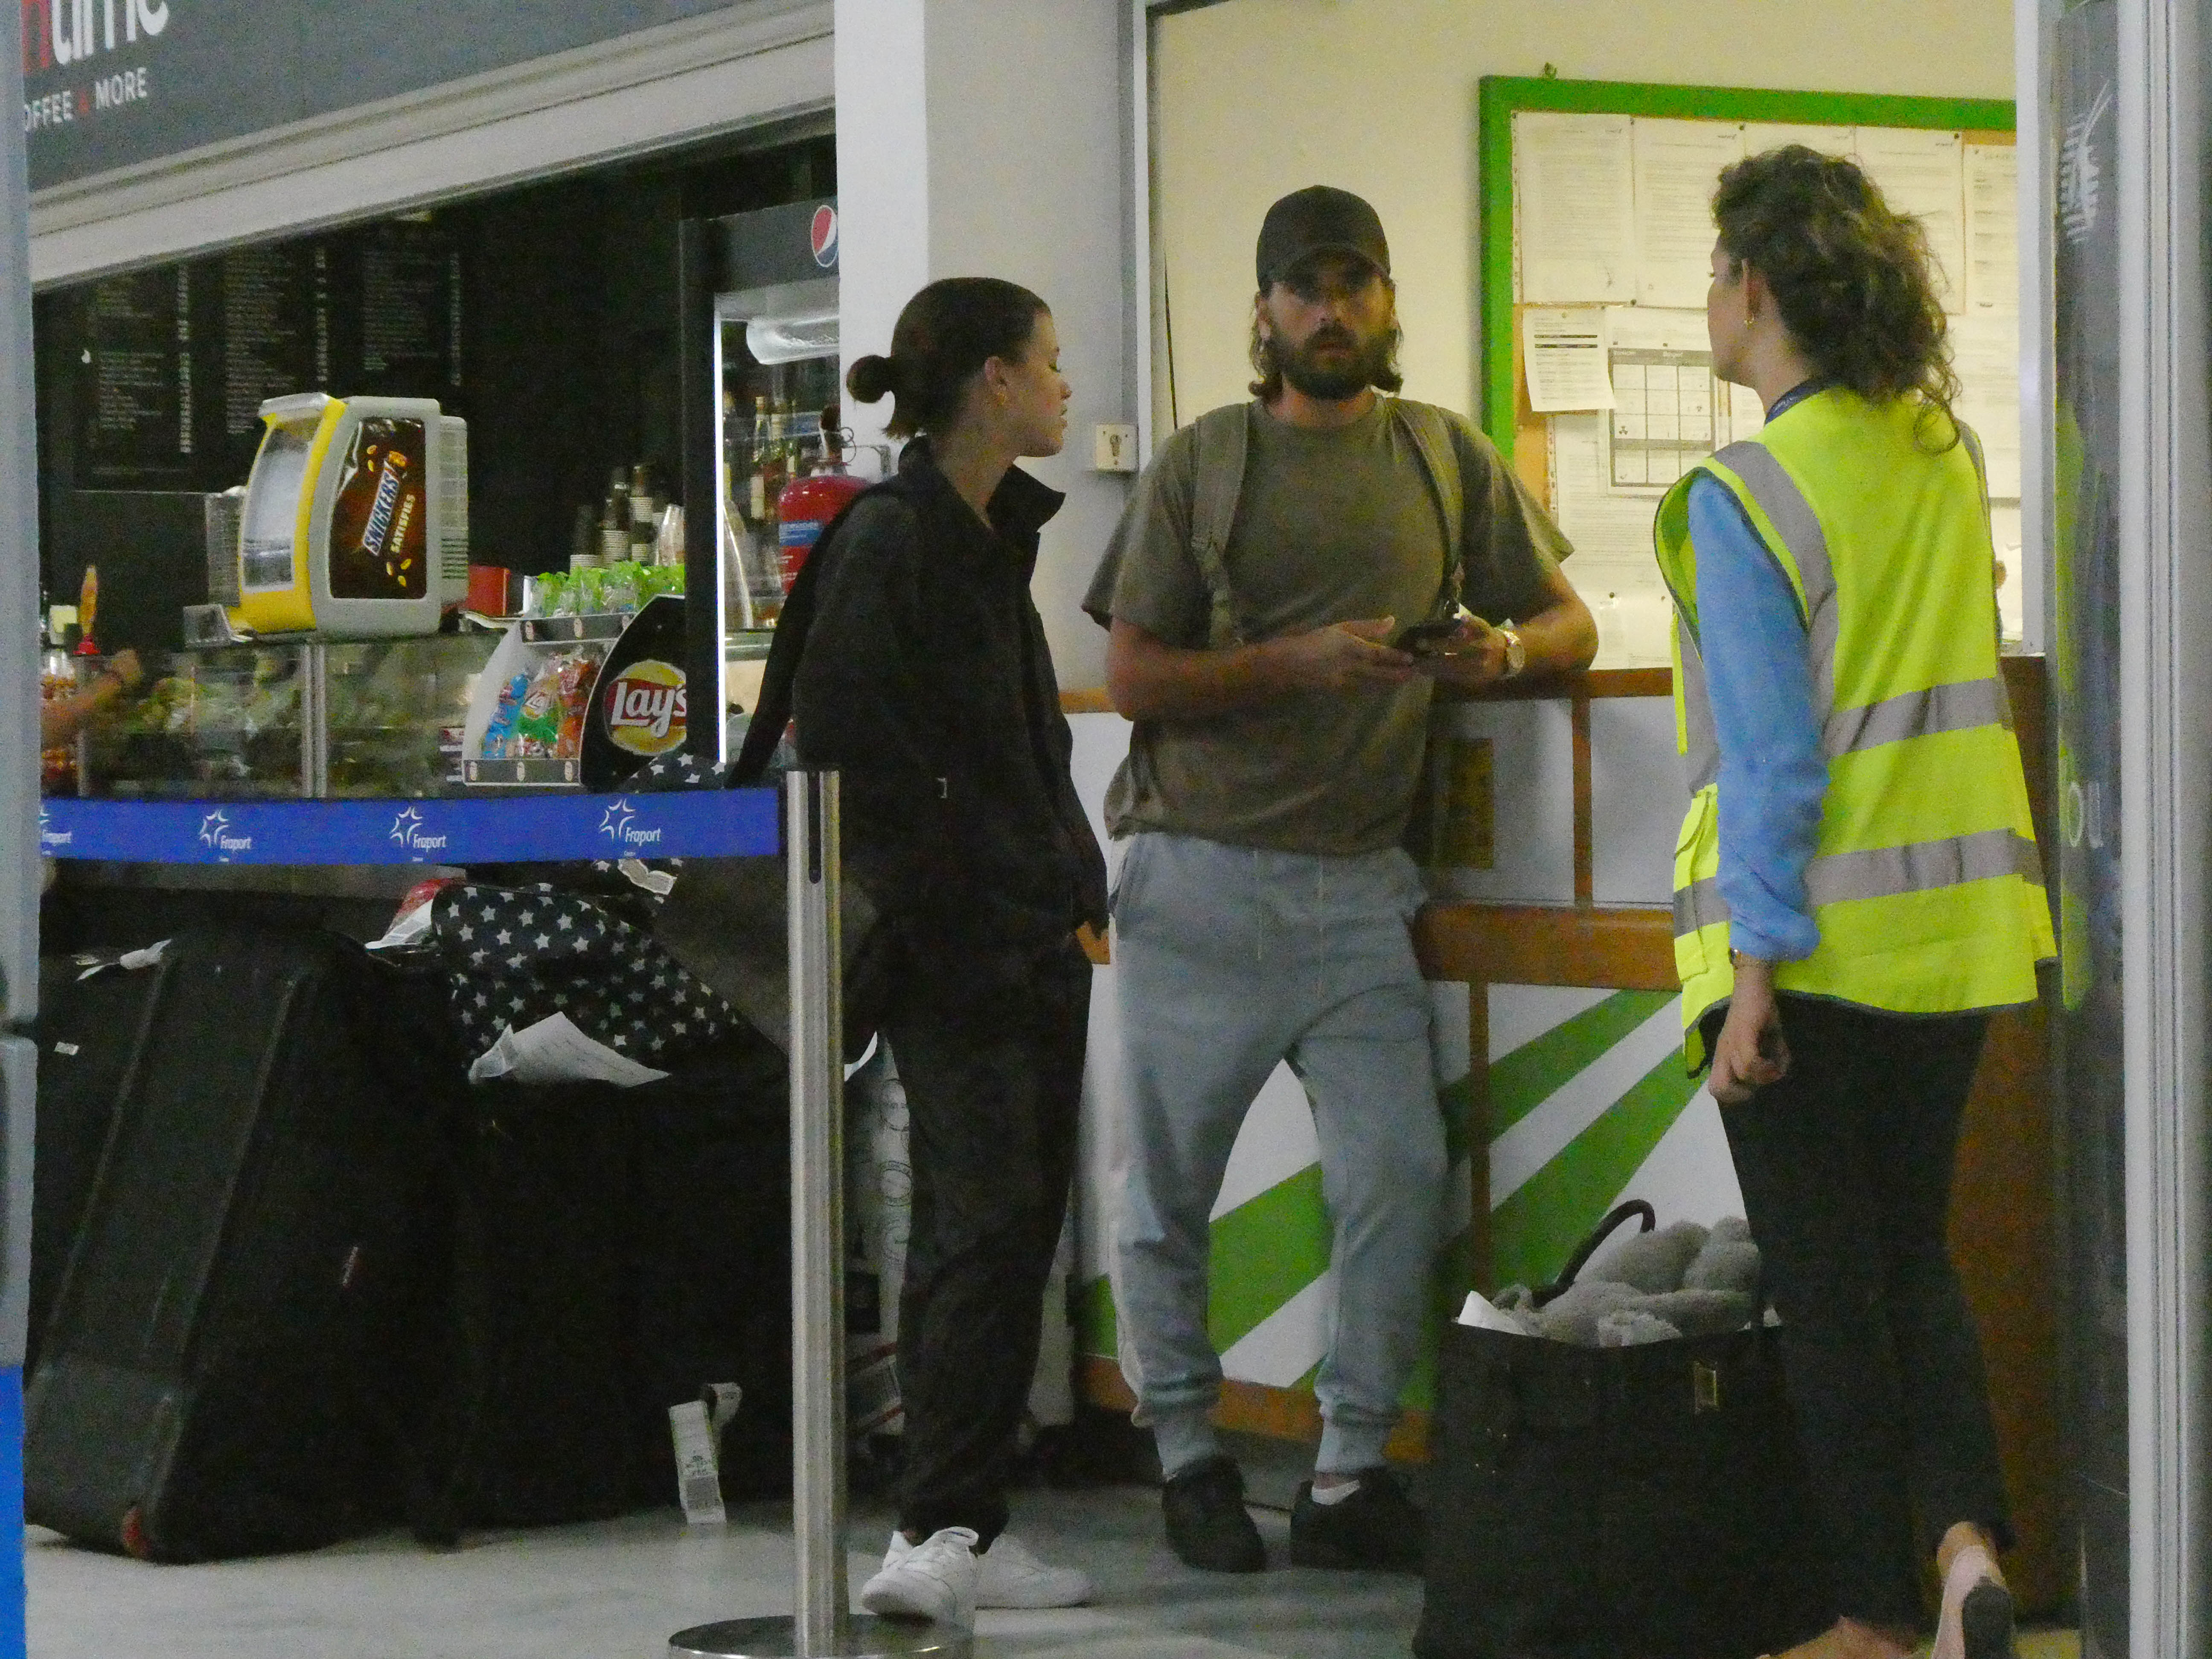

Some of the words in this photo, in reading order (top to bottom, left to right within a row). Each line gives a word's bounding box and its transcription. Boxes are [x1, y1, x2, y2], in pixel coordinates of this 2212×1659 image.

[96, 67, 147, 109] MORE
[364, 470, 399, 553] SNICKERS
[221, 835, 252, 852] Fraport
[413, 834, 446, 853] Fraport
[625, 827, 661, 847] Fraport
